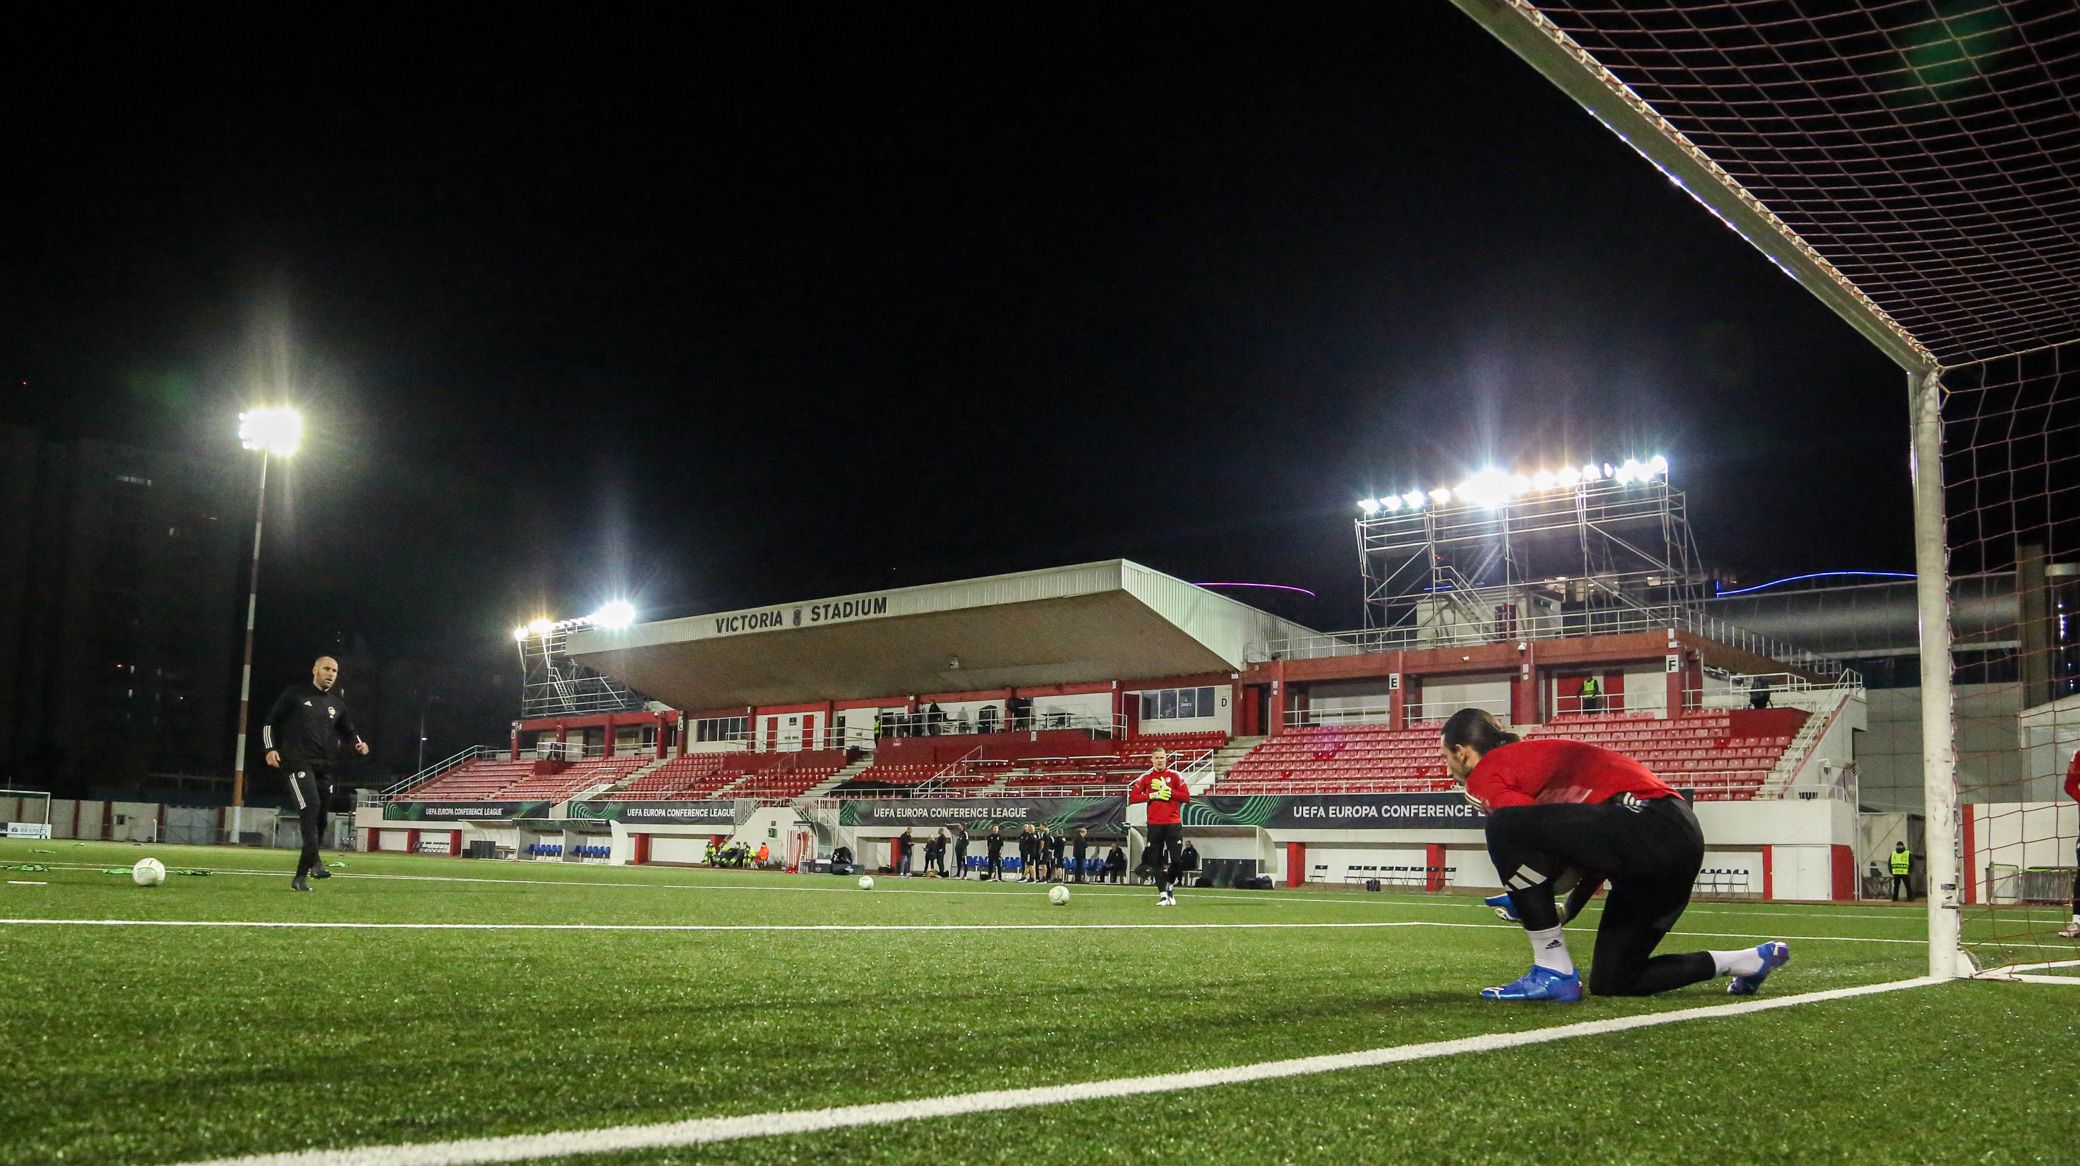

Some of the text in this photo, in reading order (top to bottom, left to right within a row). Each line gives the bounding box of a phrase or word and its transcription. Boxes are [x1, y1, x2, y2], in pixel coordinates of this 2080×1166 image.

[715, 597, 887, 633] VICTORIA STADIUM
[1668, 660, 1676, 671] F
[1391, 678, 1398, 688] E
[1221, 698, 1228, 707] D
[667, 808, 708, 817] CONFERENCE
[709, 808, 735, 817] LEAGUE
[874, 807, 1027, 818] UEFA EUROPA CONFERENCE LEAGUE
[1293, 806, 1326, 818] UEFA
[1328, 805, 1379, 818] EUROPA
[1381, 804, 1473, 817] CONFERENCE
